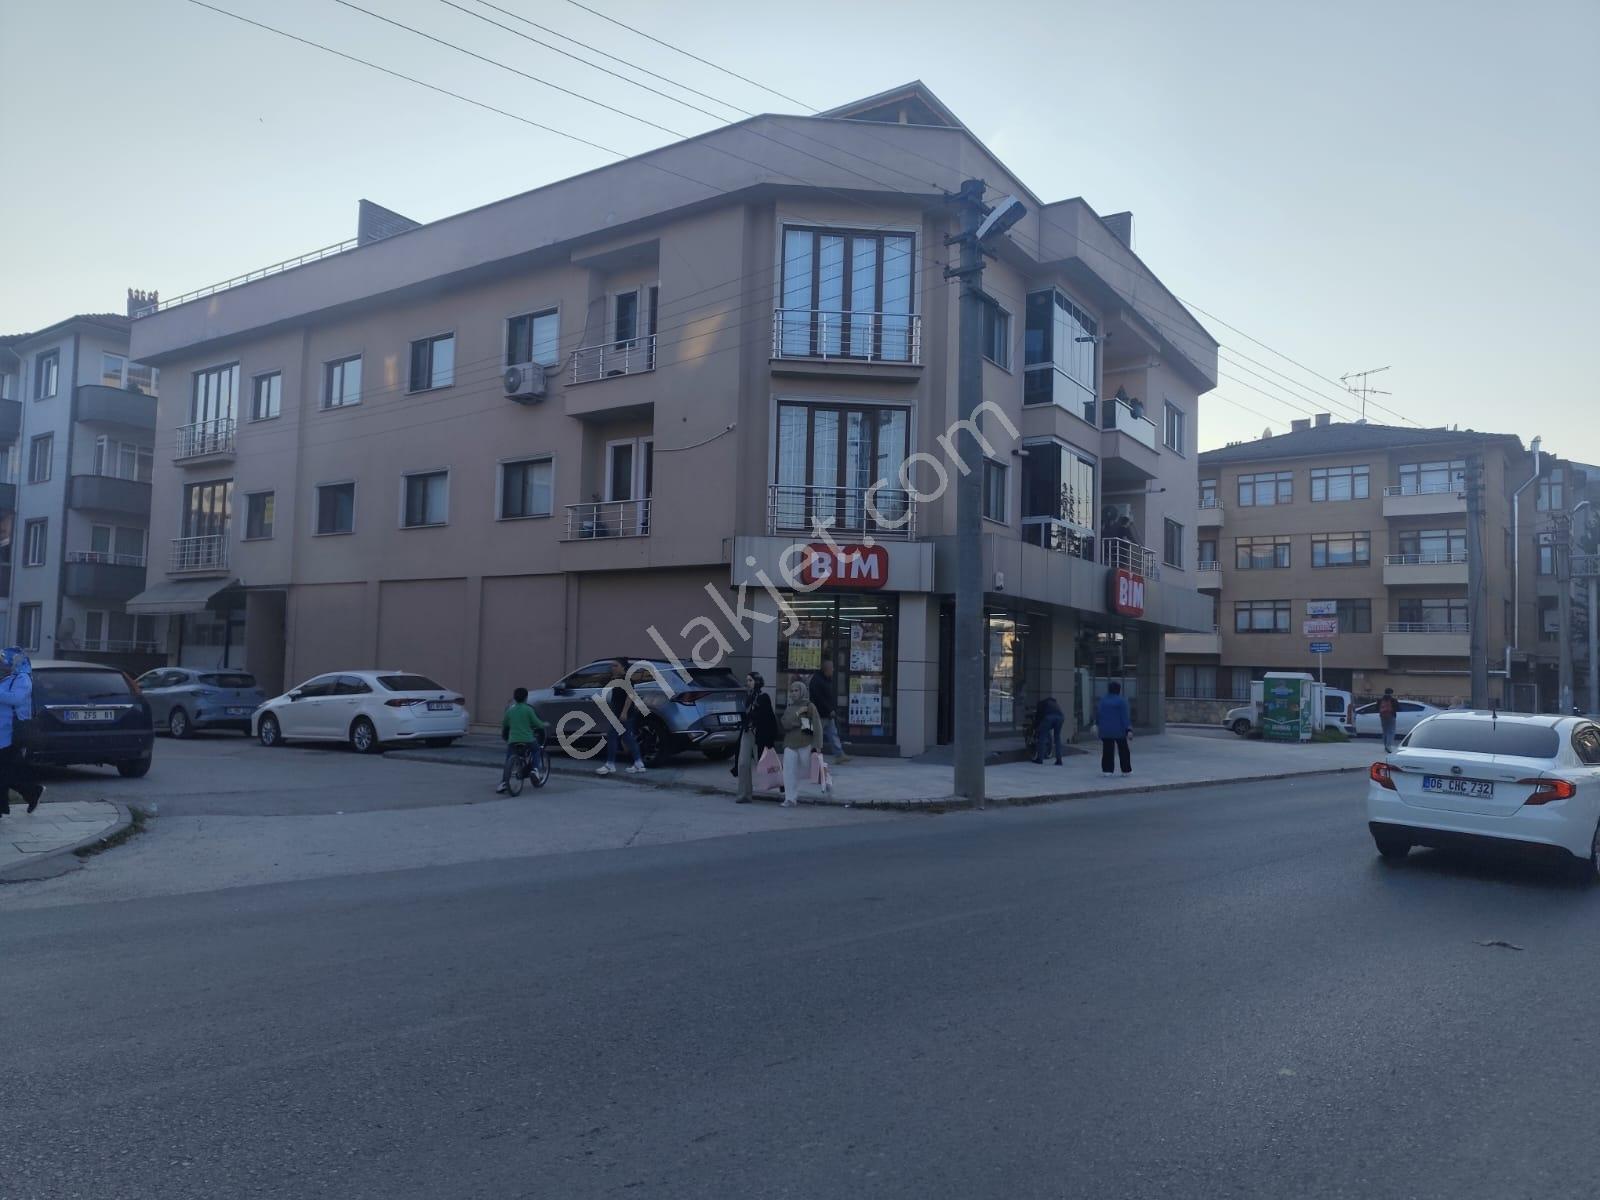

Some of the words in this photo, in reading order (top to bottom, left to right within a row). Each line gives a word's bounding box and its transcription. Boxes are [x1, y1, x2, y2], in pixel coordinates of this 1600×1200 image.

[1430, 779, 1443, 789] 06
[1448, 780, 1467, 792] CHC
[1471, 782, 1490, 795] 732
